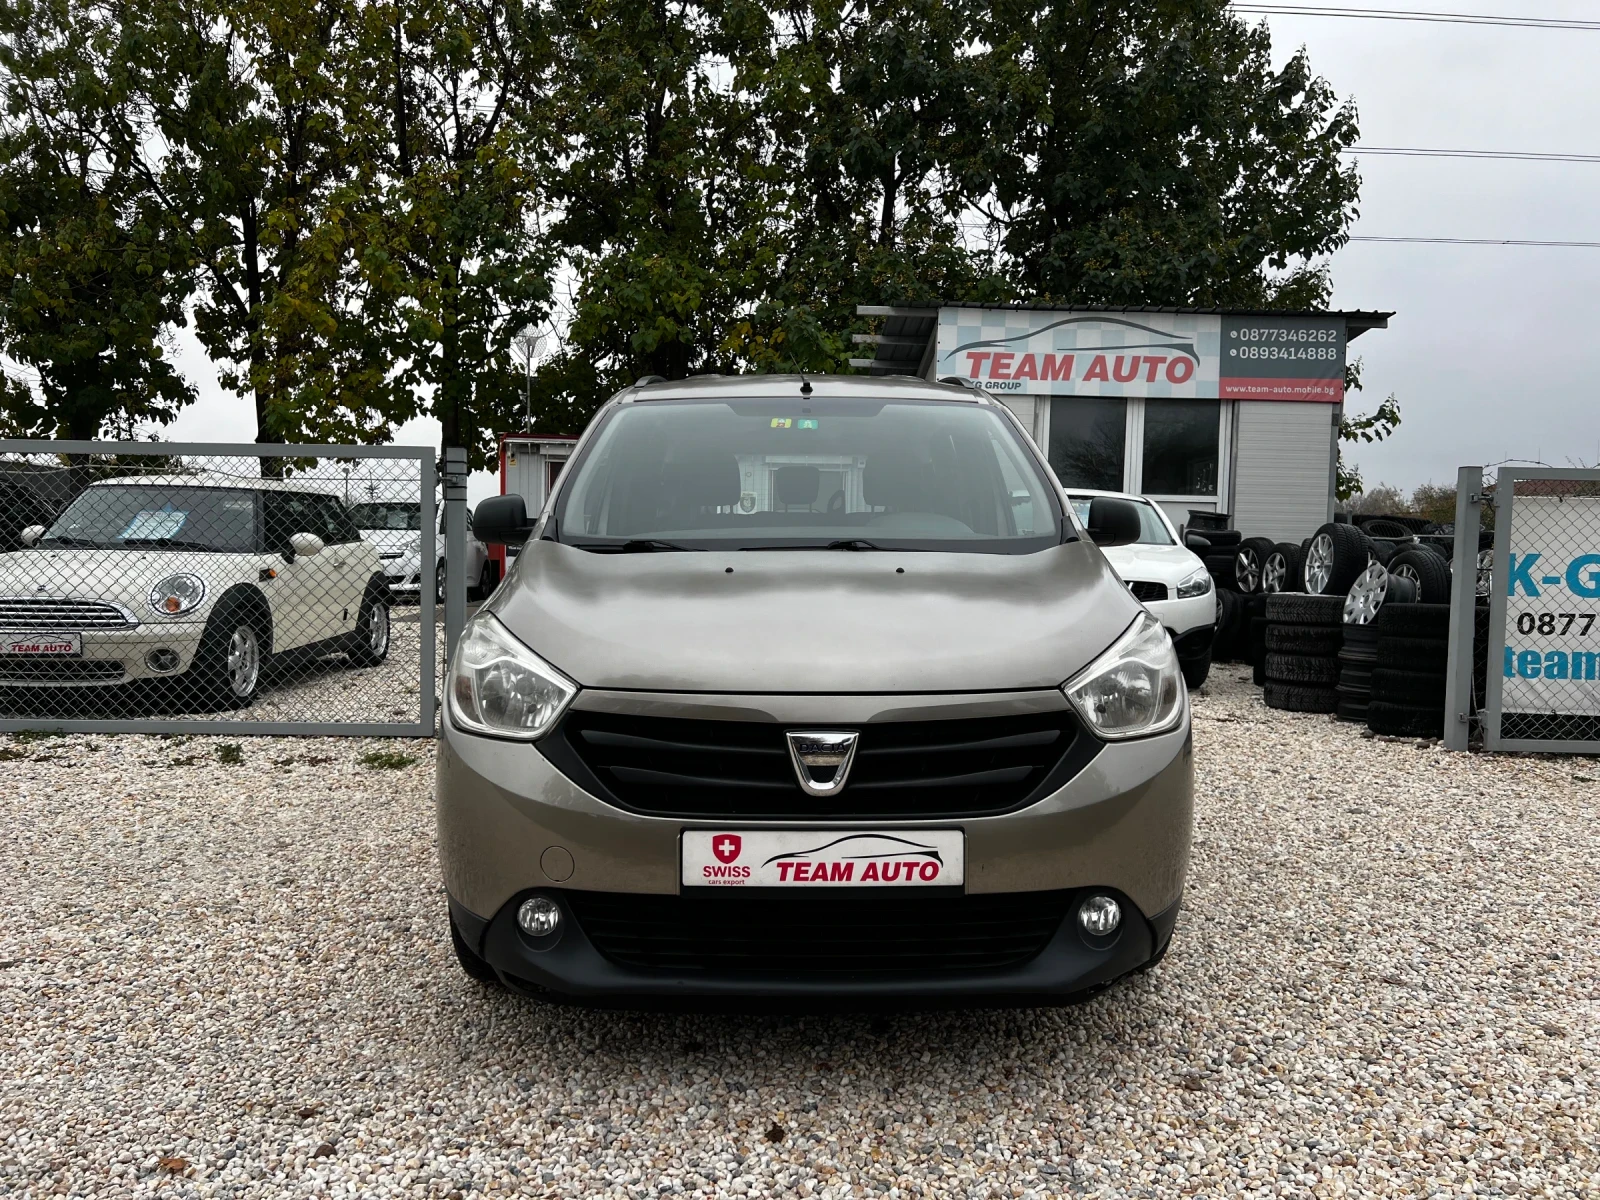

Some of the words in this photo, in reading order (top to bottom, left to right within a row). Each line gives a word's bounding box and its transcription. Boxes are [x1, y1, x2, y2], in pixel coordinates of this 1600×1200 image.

[1240, 328, 1337, 342] 0877346262
[1240, 346, 1337, 360] 0893414888
[966, 352, 1075, 381] TEAM
[1082, 355, 1194, 384] AUTO
[985, 382, 1021, 390] GROUP
[1225, 385, 1335, 395] www.team-auto.mobile.bg
[1517, 612, 1597, 636] 0877
[11, 644, 40, 652] TEAM
[44, 644, 72, 652] AUTO
[800, 743, 846, 753] DACIA
[703, 865, 751, 878] SWISS
[776, 861, 854, 882] TEAM
[860, 861, 940, 882] AUTO
